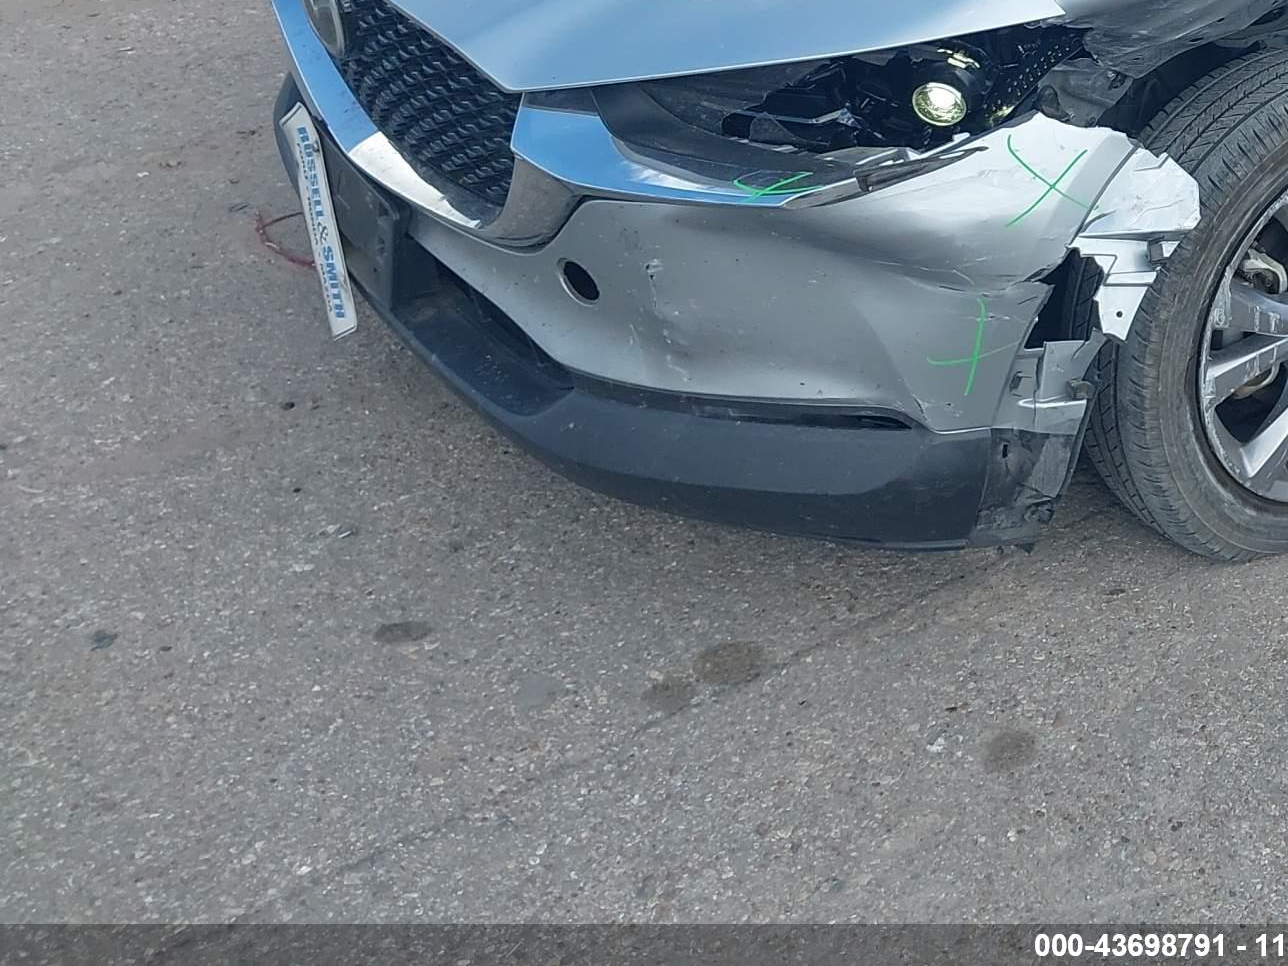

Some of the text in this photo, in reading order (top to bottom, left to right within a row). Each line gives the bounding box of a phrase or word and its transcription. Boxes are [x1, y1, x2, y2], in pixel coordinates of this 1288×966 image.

[297, 127, 346, 319] RUSSELL & SMITH
